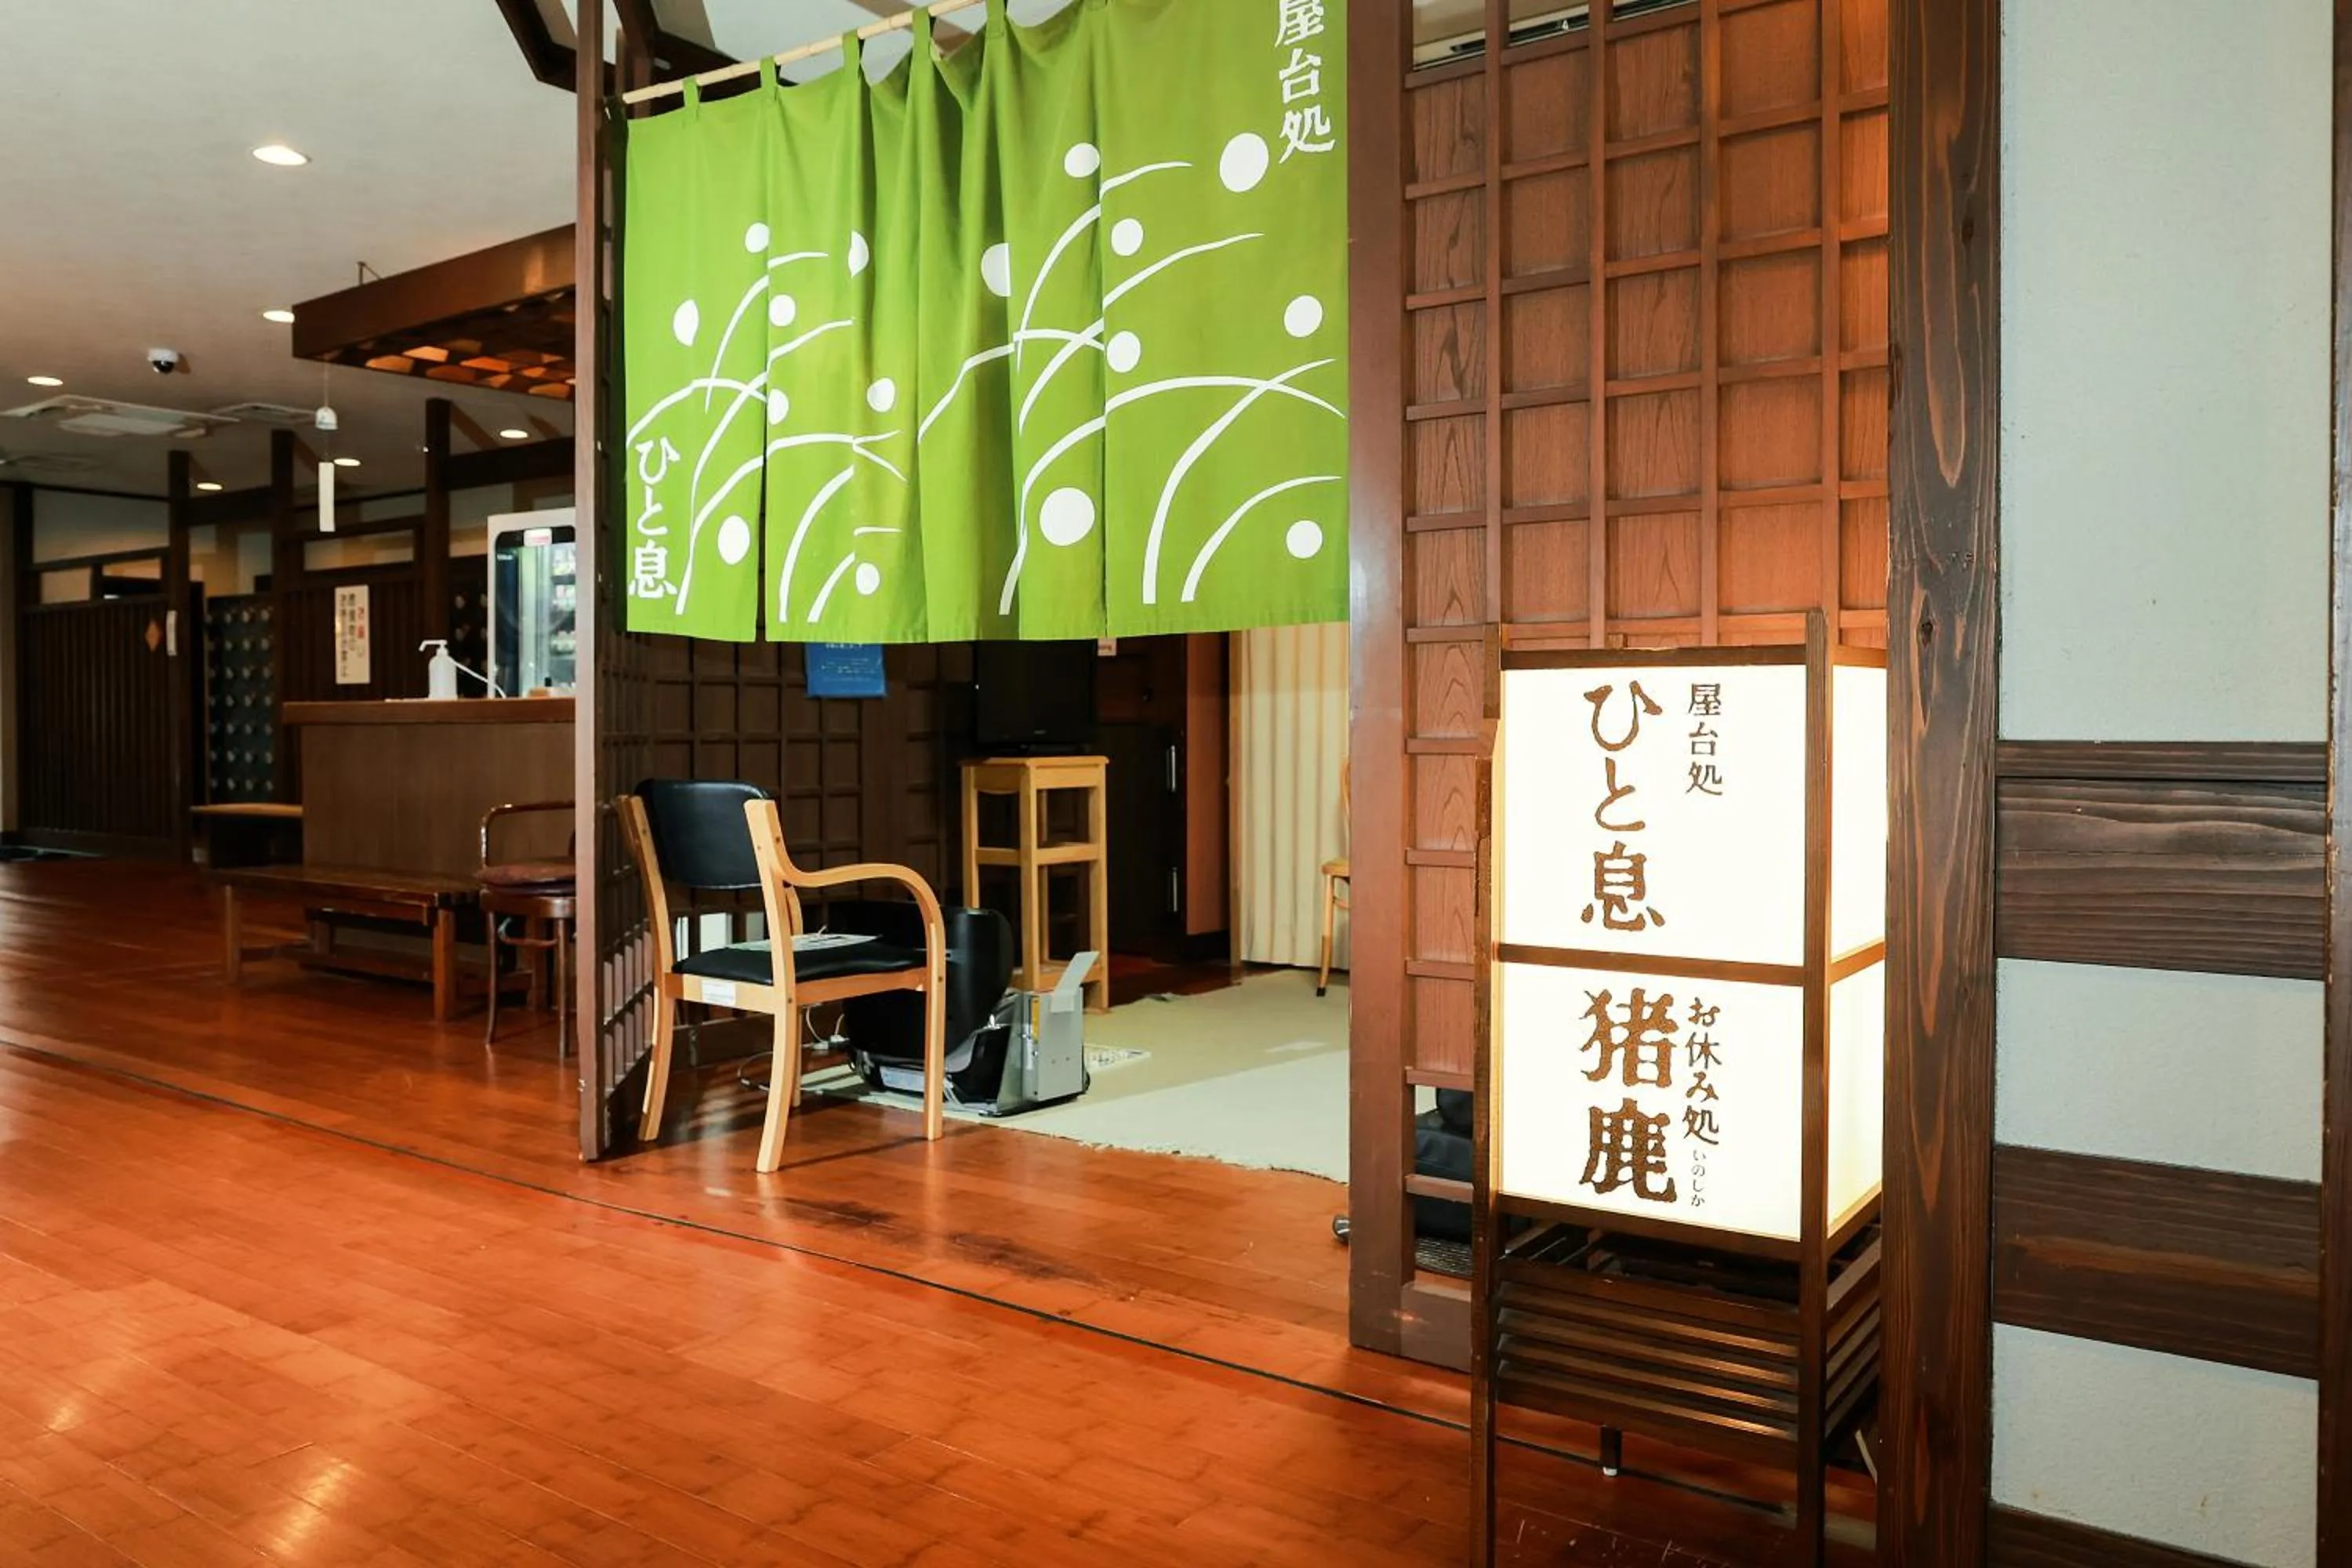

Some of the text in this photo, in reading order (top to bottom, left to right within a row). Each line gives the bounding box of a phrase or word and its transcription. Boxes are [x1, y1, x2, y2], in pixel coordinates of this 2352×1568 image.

[1275, 0, 1335, 164] 屋台処
[628, 437, 681, 598] ひと息
[1579, 679, 1666, 932] ひと息
[1686, 682, 1724, 797] 屋台処
[1577, 986, 1679, 1203] 猪鹿
[1682, 996, 1722, 1145] お休み処
[1690, 1149, 1707, 1207] いのしか
